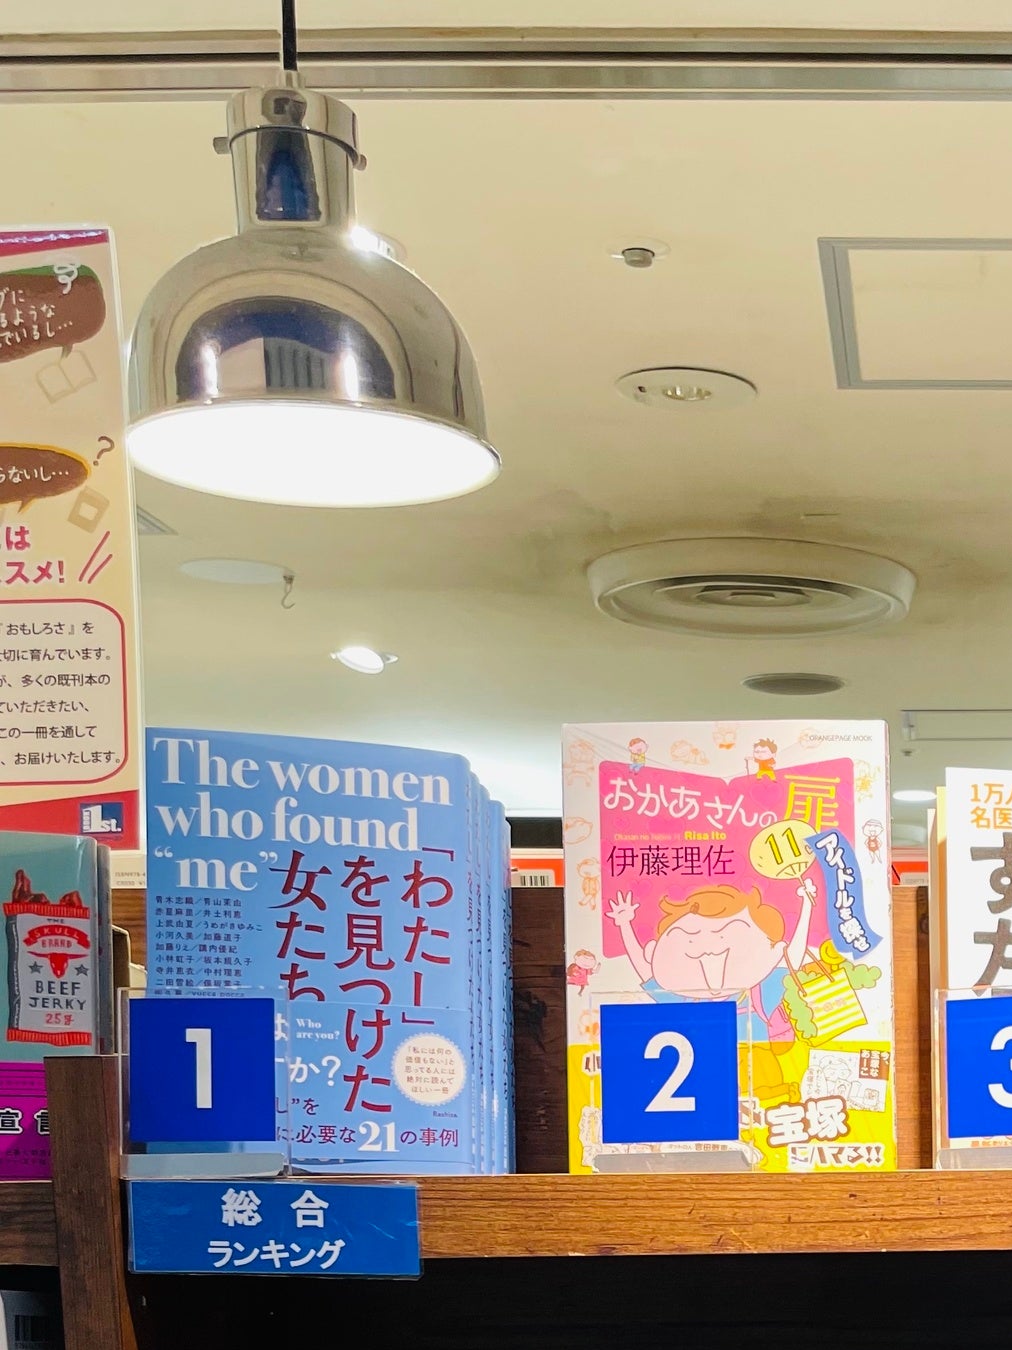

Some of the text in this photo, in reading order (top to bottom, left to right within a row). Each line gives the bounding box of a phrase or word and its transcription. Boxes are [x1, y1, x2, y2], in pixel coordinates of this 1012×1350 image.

[152, 736, 453, 806] The women
[155, 791, 421, 852] who found
[684, 830, 727, 841] Risa Ito
[607, 844, 736, 877] 伊藤理佐
[268, 850, 332, 1003] 女たち
[402, 847, 456, 1026] 「わたし」
[29, 996, 87, 1010] JERKY
[35, 980, 82, 996] BEEF
[336, 855, 395, 1114] を見つけた
[296, 1018, 322, 1029] Who
[315, 1031, 341, 1042] you?
[185, 1027, 213, 1109] 1
[643, 1030, 696, 1113] 2
[768, 1097, 848, 1145] 宝塚
[220, 1187, 330, 1229] 総合
[207, 1239, 346, 1270] ランキング
